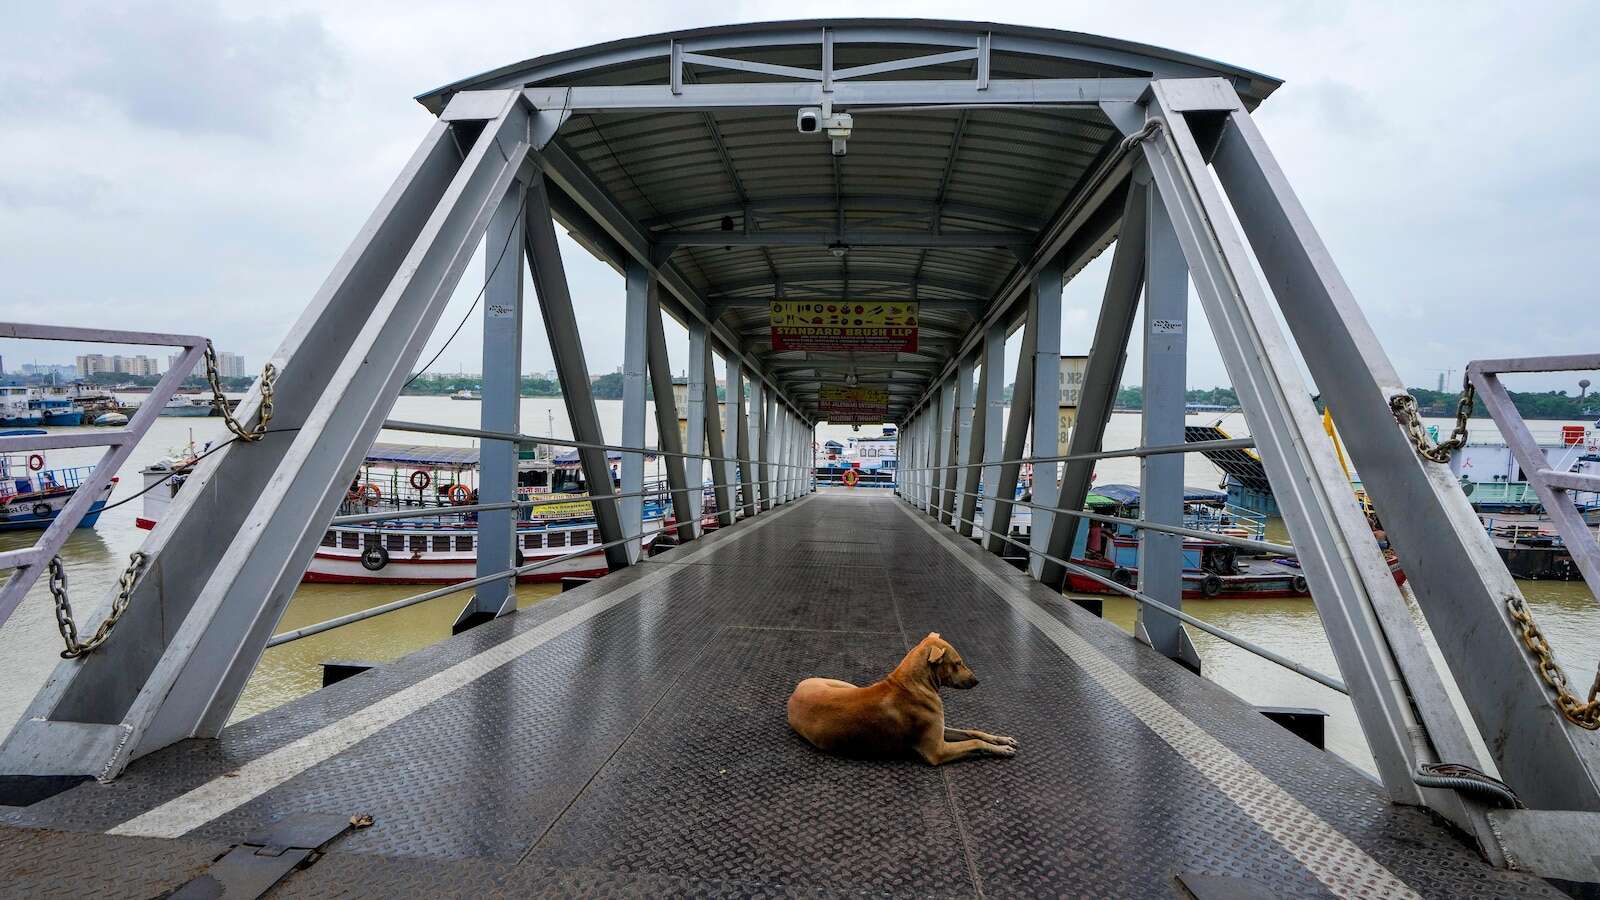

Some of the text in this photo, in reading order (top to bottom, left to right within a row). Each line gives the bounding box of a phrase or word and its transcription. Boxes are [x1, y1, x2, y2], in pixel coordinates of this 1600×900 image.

[777, 327, 913, 336] STANDARD BRUSH LLP
